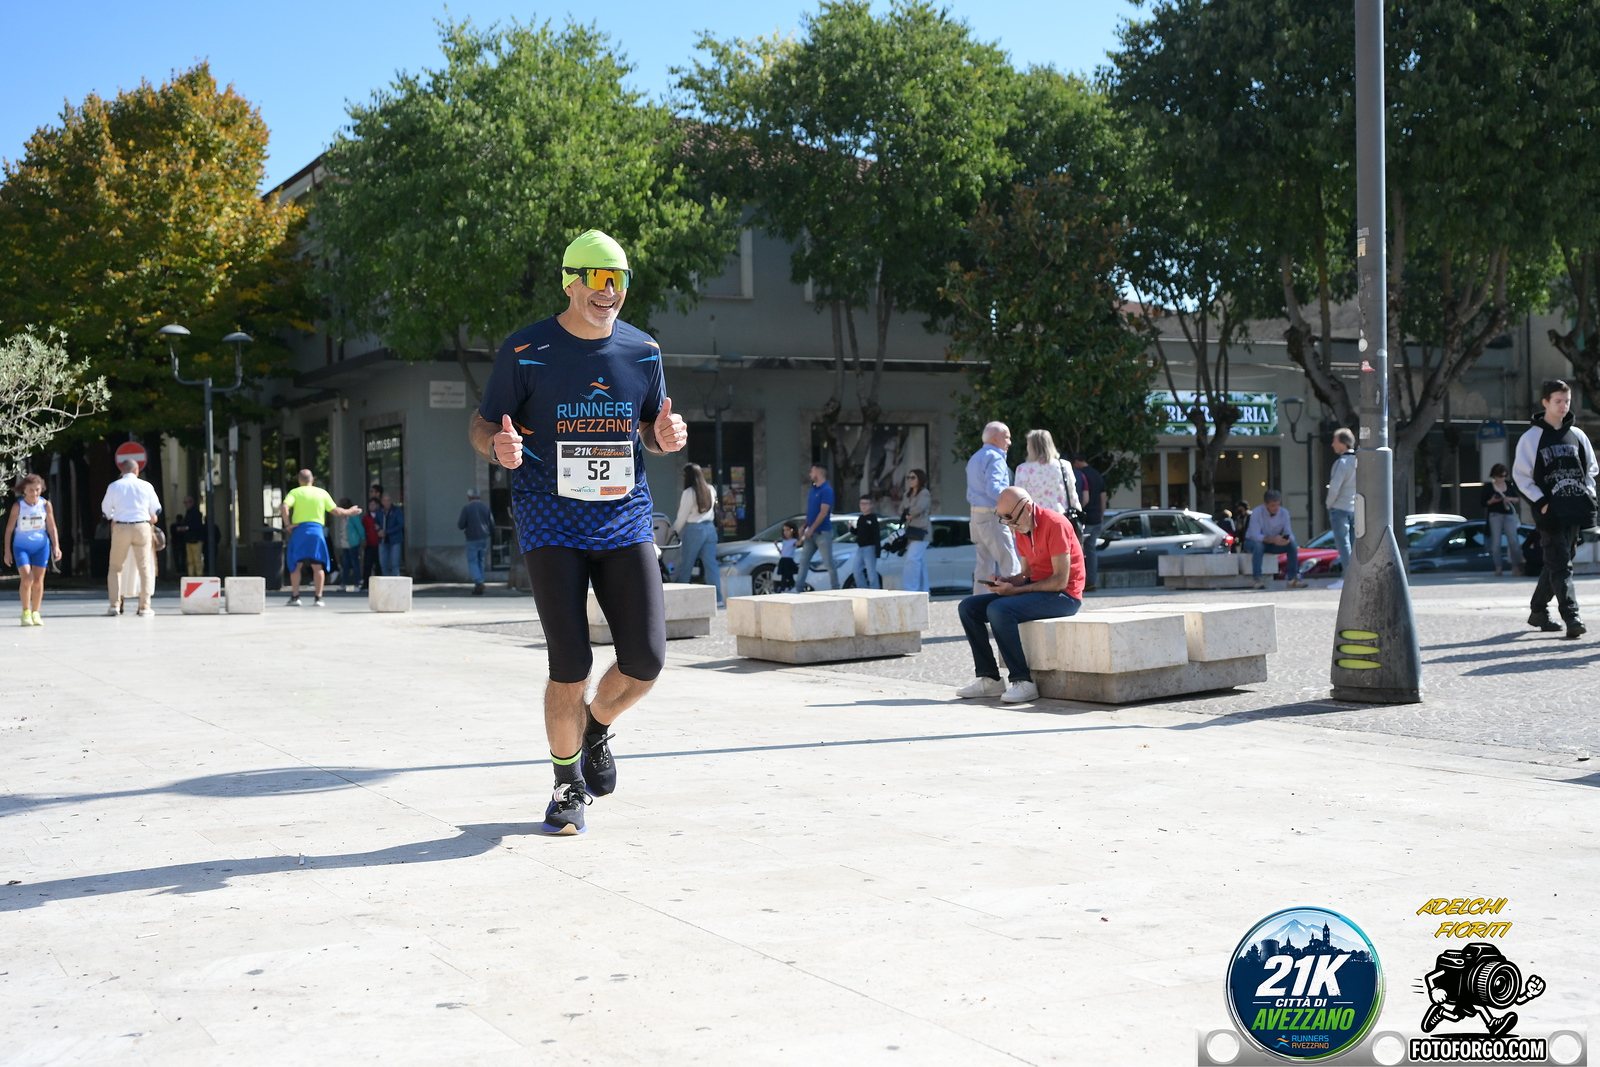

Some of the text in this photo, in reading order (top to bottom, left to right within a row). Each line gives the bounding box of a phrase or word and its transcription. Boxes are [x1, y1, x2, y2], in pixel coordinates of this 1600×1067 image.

[557, 402, 633, 419] RUNNERS
[556, 419, 632, 434] AVEZZANO
[574, 447, 592, 456] 21K
[588, 460, 610, 480] 52
